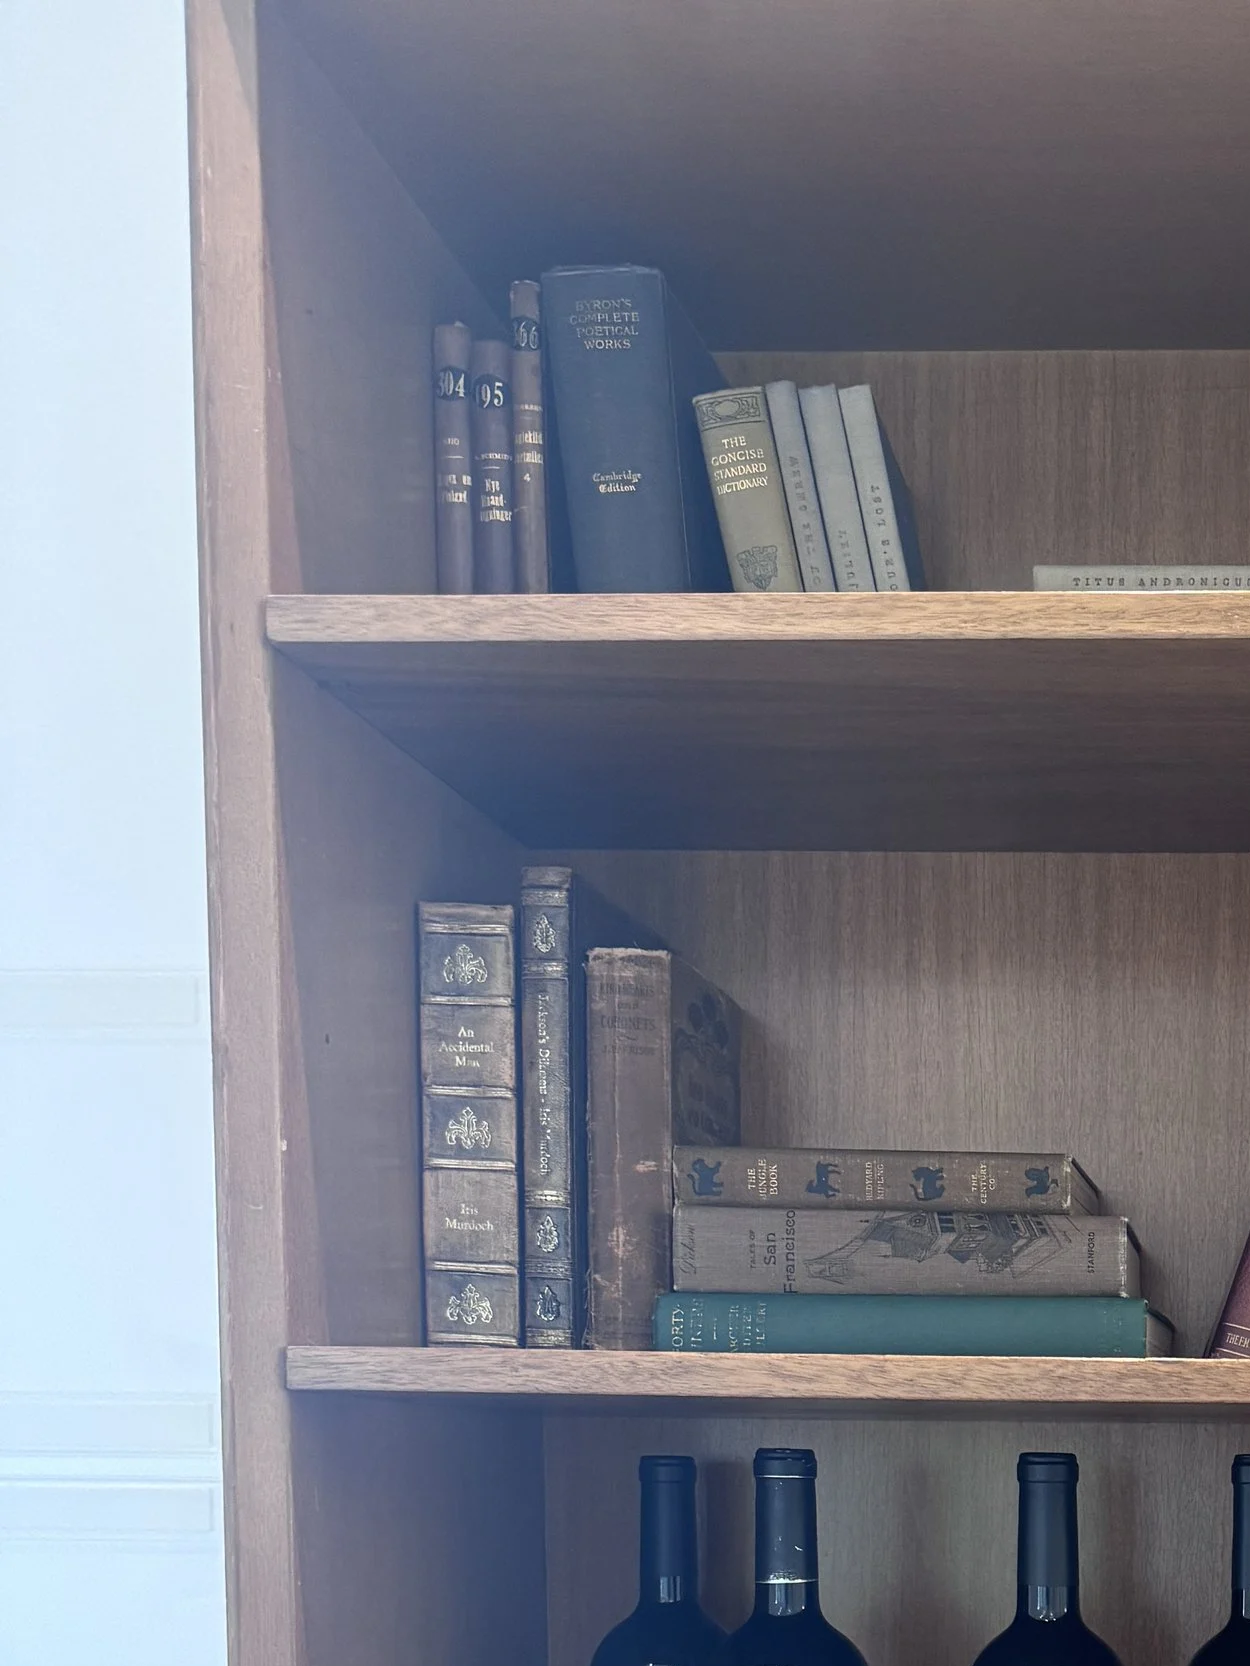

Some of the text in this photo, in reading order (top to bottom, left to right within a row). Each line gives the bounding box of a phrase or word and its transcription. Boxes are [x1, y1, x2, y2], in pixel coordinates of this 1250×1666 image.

[575, 297, 633, 312] BYRON'S
[569, 311, 640, 326] COMPLETE
[576, 324, 640, 339] POETICAL
[583, 338, 633, 350] WORKS
[721, 435, 748, 449] THE
[711, 448, 765, 468] CONCISE
[592, 469, 643, 483] Cambridge
[714, 462, 768, 481] STANDARD
[598, 482, 637, 493] Edition
[716, 476, 770, 496] DICTIONARY
[1072, 577, 1126, 587] TITUS
[457, 1025, 476, 1038] An
[438, 1040, 496, 1053] Accidental
[747, 1167, 757, 1190] THE
[757, 1157, 768, 1200] JUNGLE
[768, 1163, 779, 1195] BOOK
[875, 1162, 887, 1201] KIPLING
[971, 1173, 980, 1193] THE
[979, 1162, 989, 1206] CENTURY
[459, 1202, 479, 1216] Iris
[445, 1216, 494, 1231] Murdoch
[748, 1228, 758, 1270] TALES OF
[764, 1231, 778, 1267] San
[782, 1208, 799, 1295] Francisco
[1086, 1231, 1096, 1275] STANFORD
